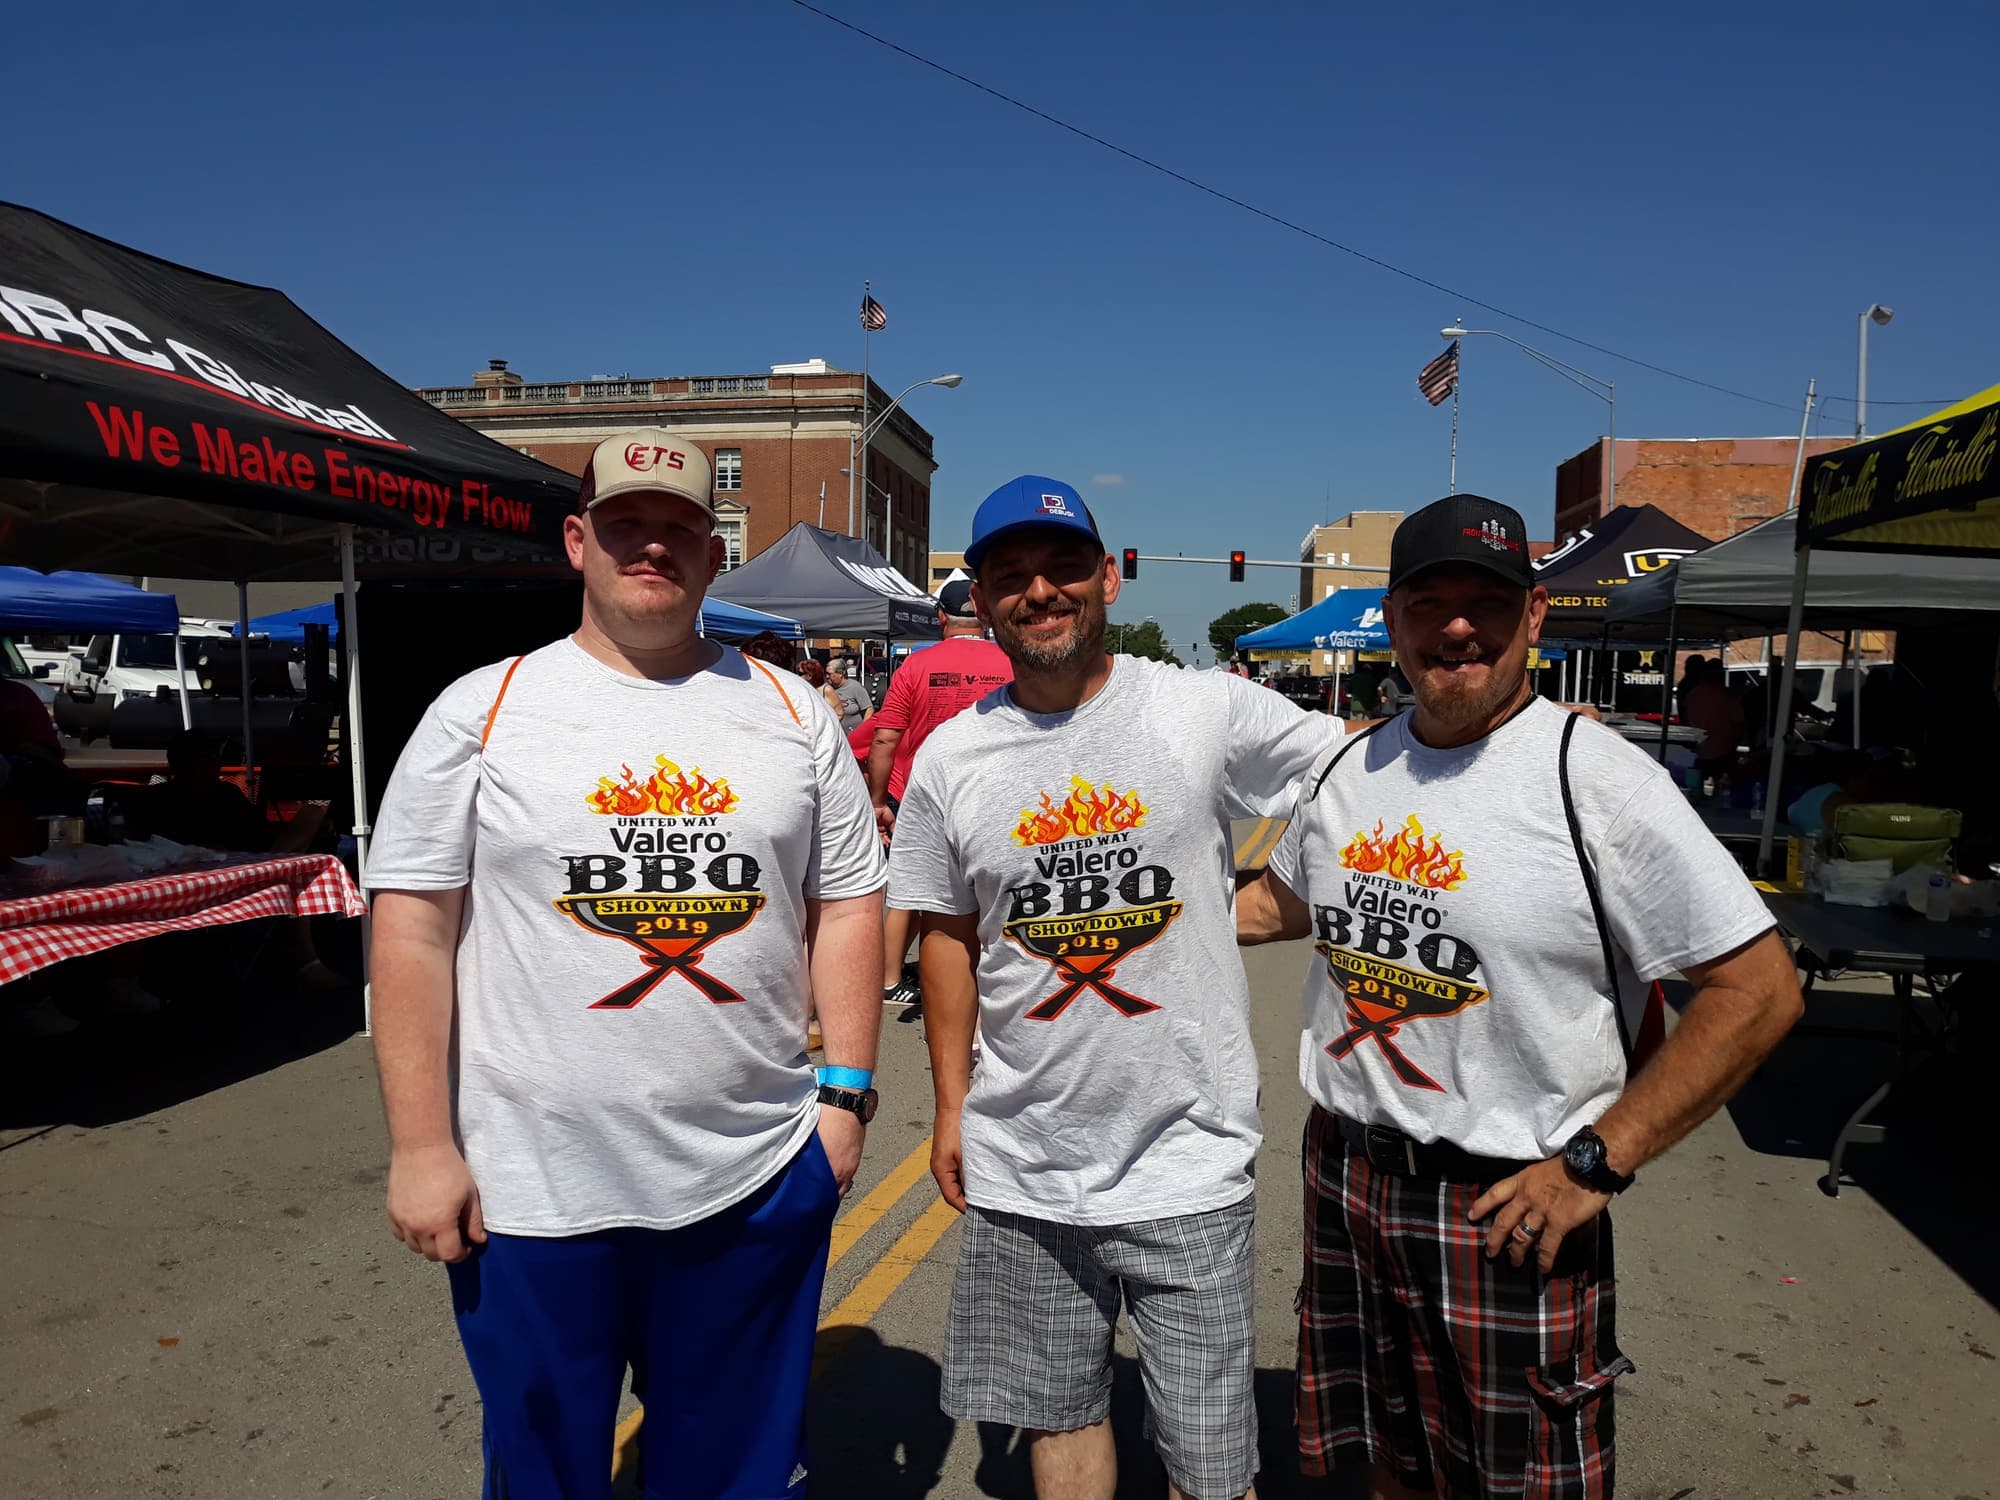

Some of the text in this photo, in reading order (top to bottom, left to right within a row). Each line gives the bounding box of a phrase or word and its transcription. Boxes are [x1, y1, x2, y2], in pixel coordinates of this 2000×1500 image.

[166, 337, 397, 440] Global
[86, 401, 181, 467] We
[192, 421, 316, 491] Make
[324, 448, 449, 528] Energy
[625, 444, 685, 471] ETS
[1547, 596, 1582, 607] NCED
[1329, 634, 1367, 648] Valero
[618, 817, 718, 827] UNITED WAY
[609, 828, 726, 853] Valero
[1039, 831, 1130, 855] UNITED WAY
[560, 853, 762, 894] BBQ
[1034, 848, 1138, 879] Valero
[1005, 865, 1175, 922] BBQ
[1352, 872, 1439, 901] UNITED WAY
[601, 899, 743, 913] SHOWDOWN
[1344, 881, 1441, 930] Valero
[635, 916, 709, 935] 2019
[1031, 912, 1156, 936] SHOWDOWN
[1056, 935, 1120, 955] 2019
[1313, 904, 1483, 984] BBQ
[1334, 952, 1451, 998] SHOWDOWN
[1347, 979, 1408, 1009] 2019
